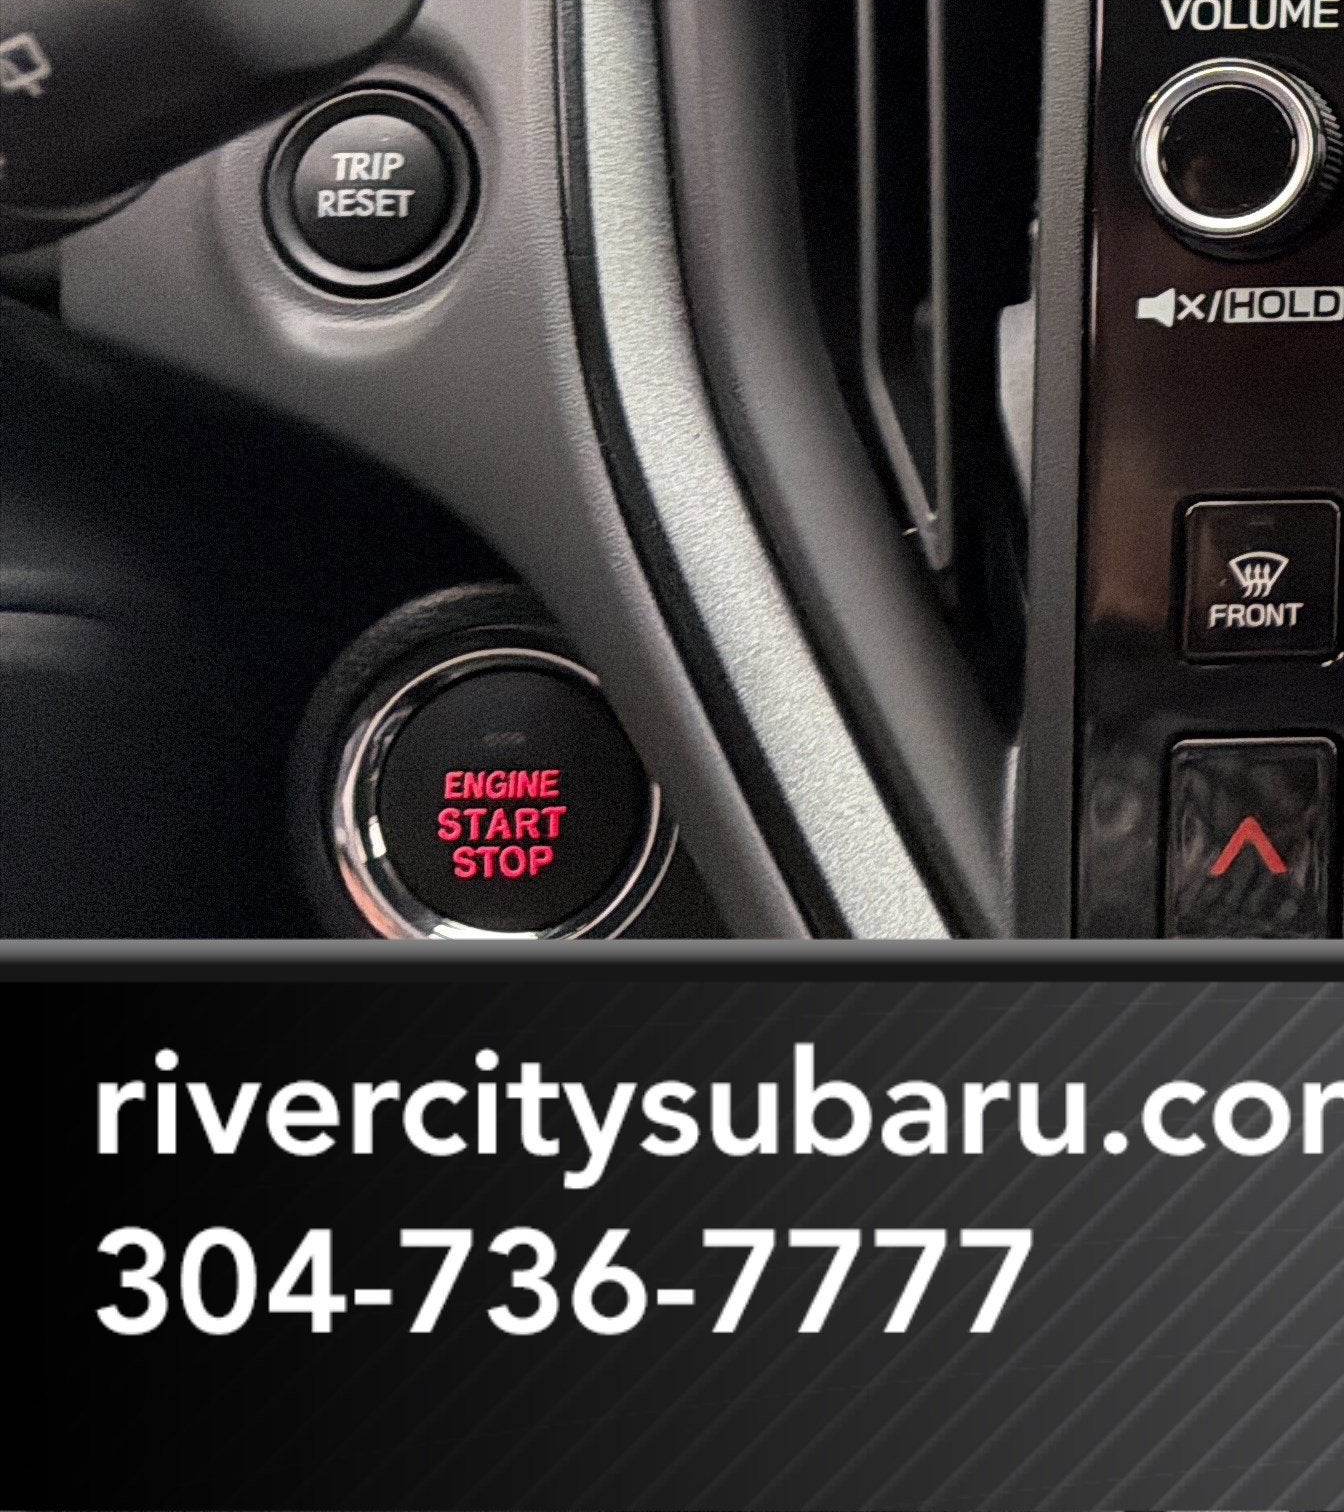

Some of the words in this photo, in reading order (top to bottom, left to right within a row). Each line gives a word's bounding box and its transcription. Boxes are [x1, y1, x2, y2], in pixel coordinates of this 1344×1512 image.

[331, 151, 406, 182] TRIP
[317, 188, 416, 218] RESET
[1208, 601, 1305, 629] FRONT
[442, 768, 562, 802] ENGINE
[436, 805, 569, 843] START
[450, 845, 556, 881] STOP
